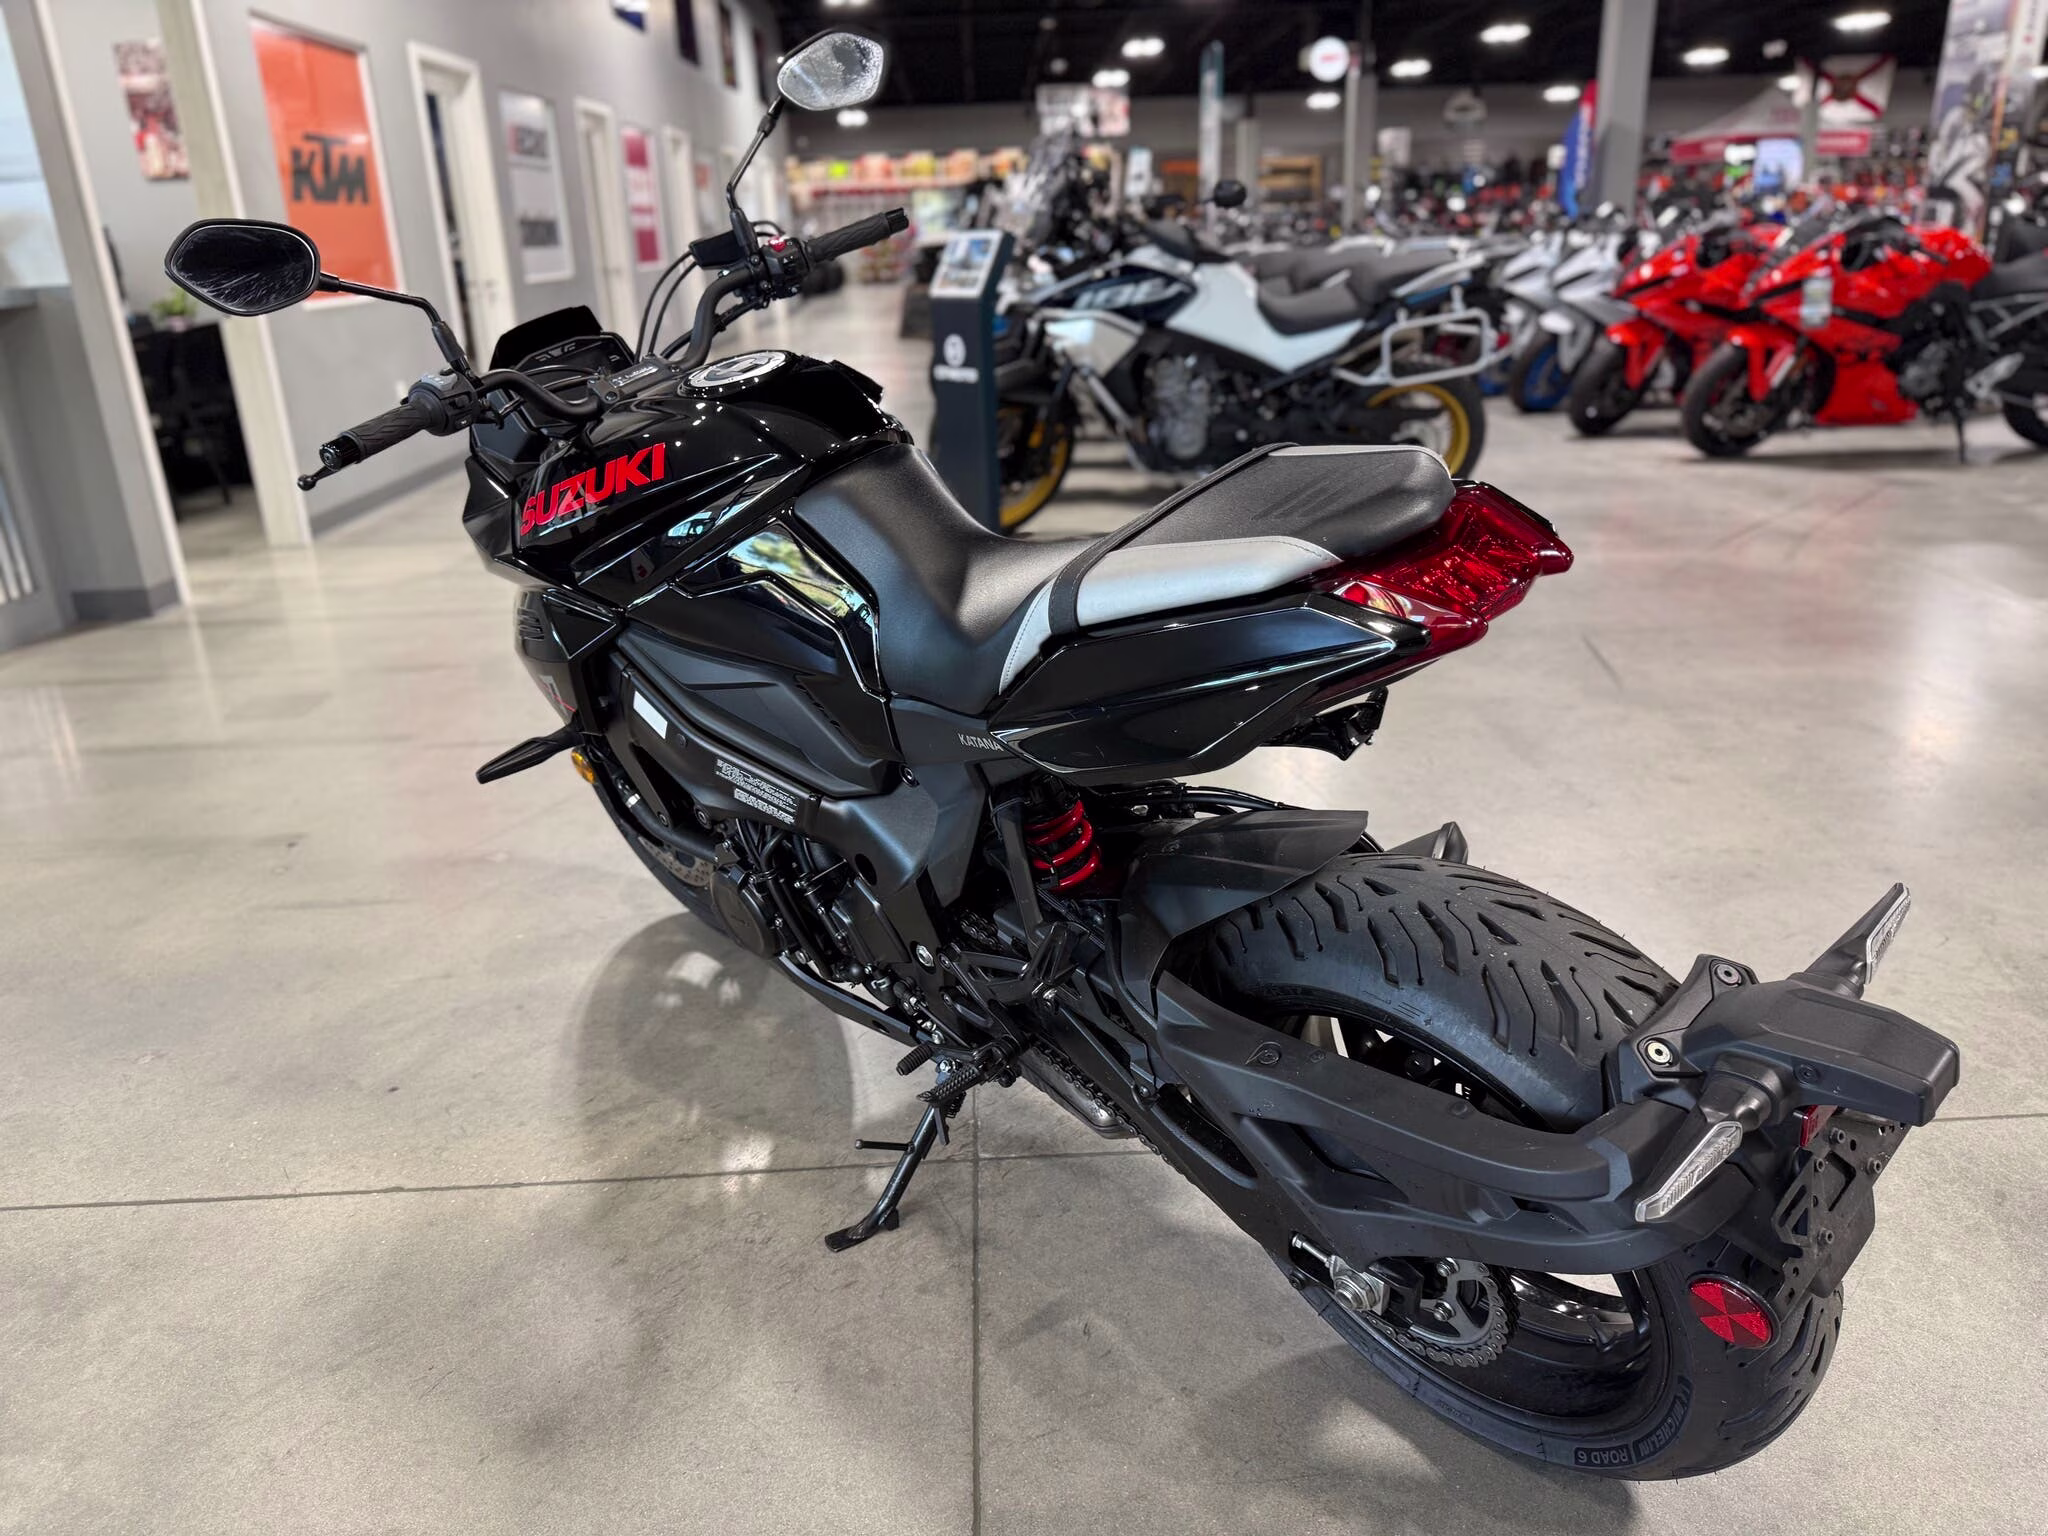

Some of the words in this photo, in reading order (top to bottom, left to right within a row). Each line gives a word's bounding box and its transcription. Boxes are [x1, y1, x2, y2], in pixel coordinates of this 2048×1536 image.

[291, 132, 369, 204] KTM
[520, 442, 666, 536] SUZUKI
[958, 733, 1004, 752] KATANA
[1638, 1399, 1686, 1458] MICHELIN
[1578, 1450, 1588, 1463] 6
[1591, 1447, 1628, 1464] ROAD
